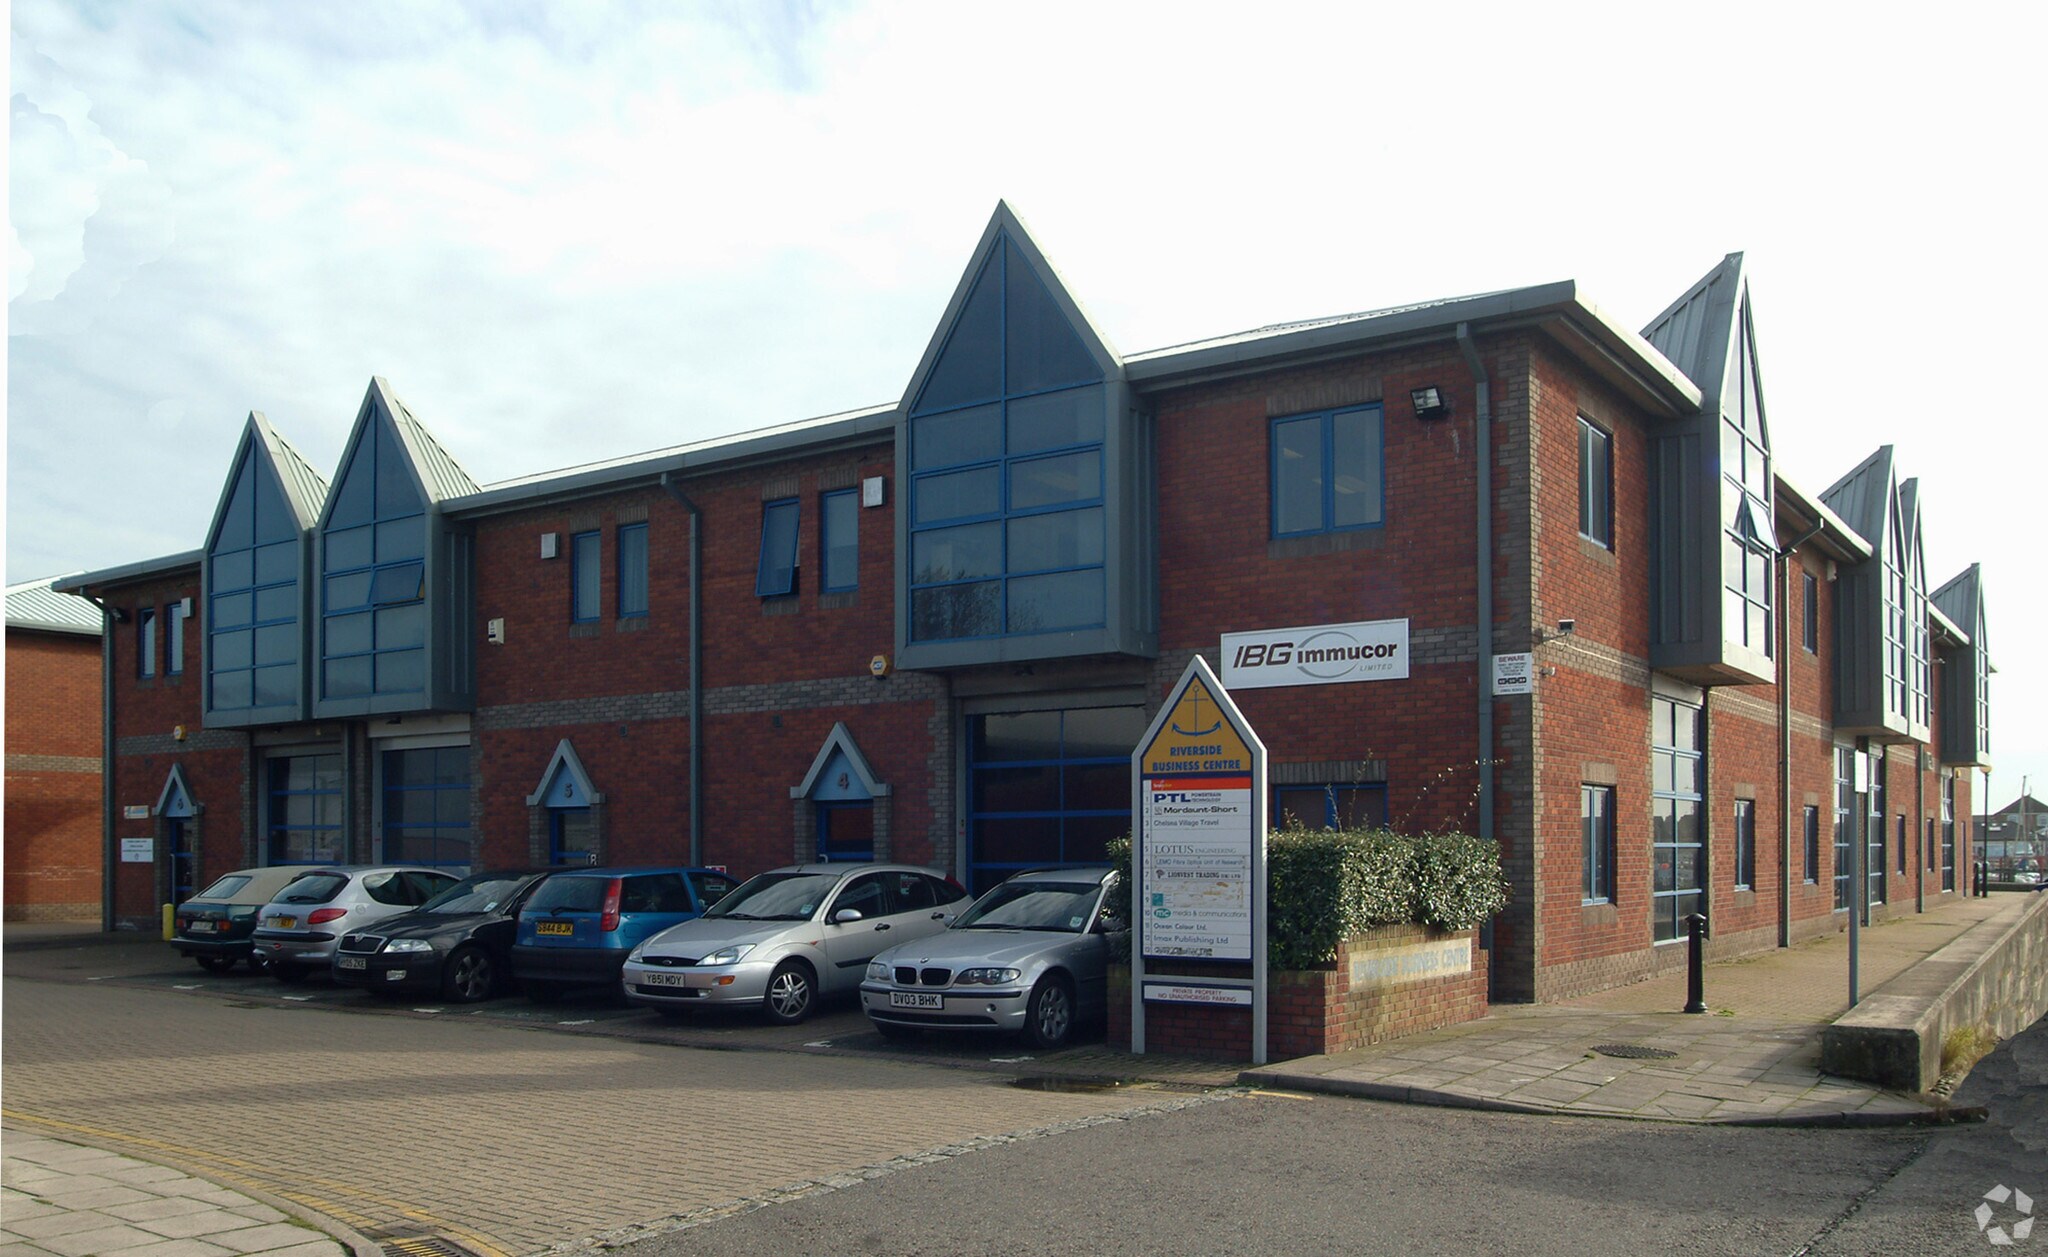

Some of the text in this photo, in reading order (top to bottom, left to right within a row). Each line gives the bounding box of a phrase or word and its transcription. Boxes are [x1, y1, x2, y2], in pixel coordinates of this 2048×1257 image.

[1233, 642, 1397, 669] IBG immucor
[1359, 663, 1393, 672] LIMITED
[1170, 745, 1222, 756] RIVERSIDE
[1152, 759, 1240, 772] BUSINESS CENTRE
[838, 772, 850, 790] 4
[564, 783, 573, 798] 5
[1154, 793, 1191, 803] PTL
[1163, 806, 1238, 814] Mordaunt-Short
[1179, 820, 1199, 828] Village
[1155, 845, 1194, 854] LOTUS
[1174, 936, 1214, 945] Publishing
[646, 974, 682, 985] Y851 MDY
[894, 993, 938, 1006] DV03 BHK
